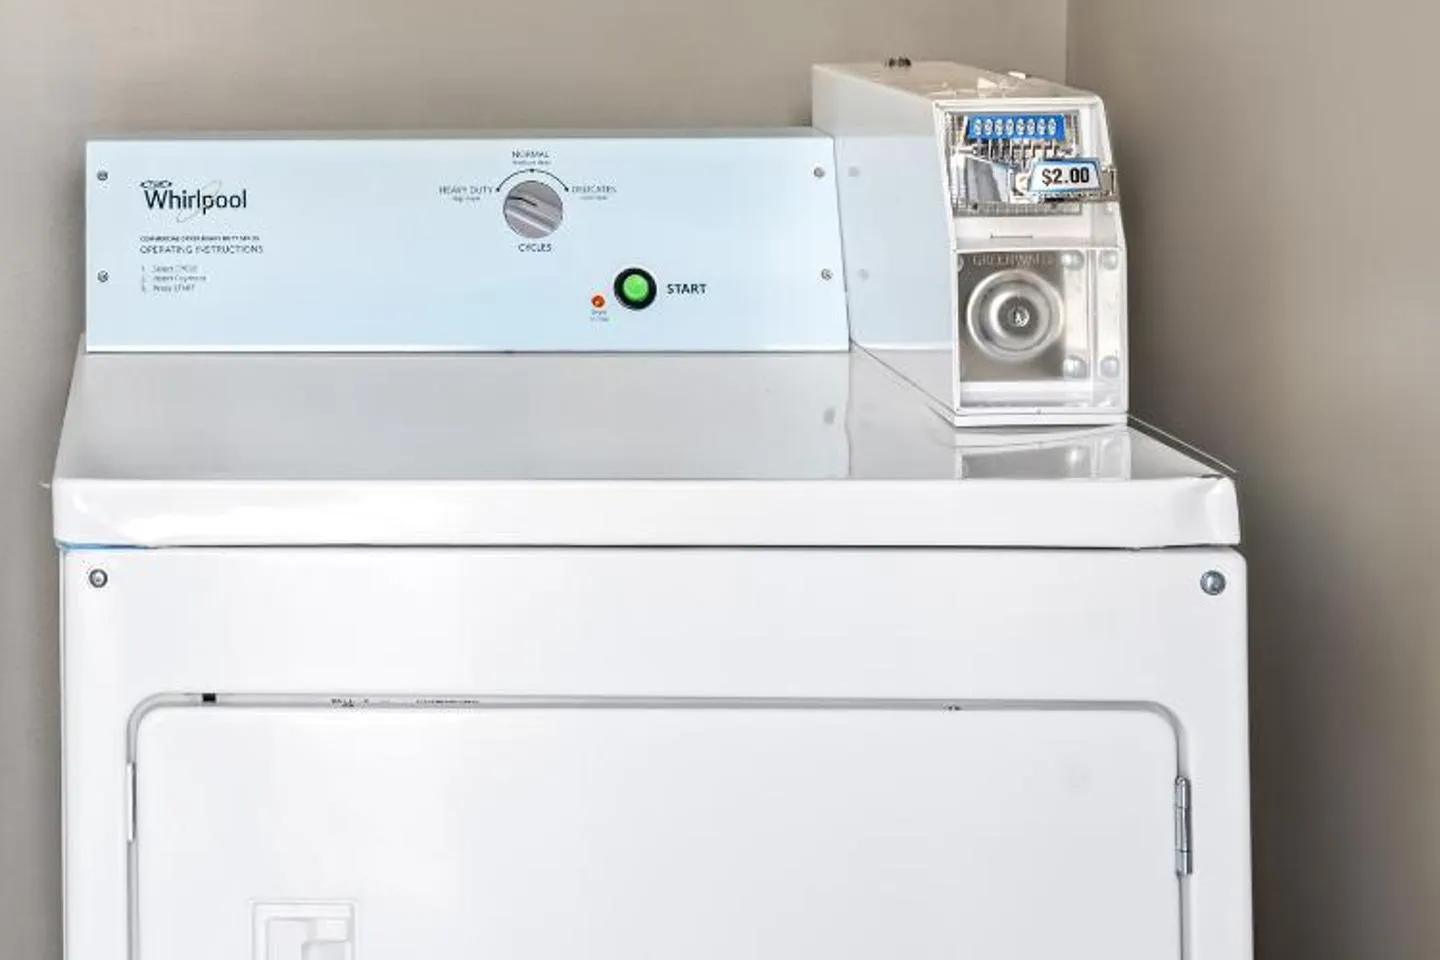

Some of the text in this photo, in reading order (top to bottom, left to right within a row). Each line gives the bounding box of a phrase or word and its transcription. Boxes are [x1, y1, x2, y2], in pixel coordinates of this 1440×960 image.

[1041, 167, 1090, 186] $2.00
[470, 185, 494, 194] DUTY
[143, 188, 247, 215] Whirlpool
[139, 245, 264, 254] OPERATING INSTRUCTIONS
[518, 243, 552, 252] CYCLES
[666, 283, 707, 294] START
